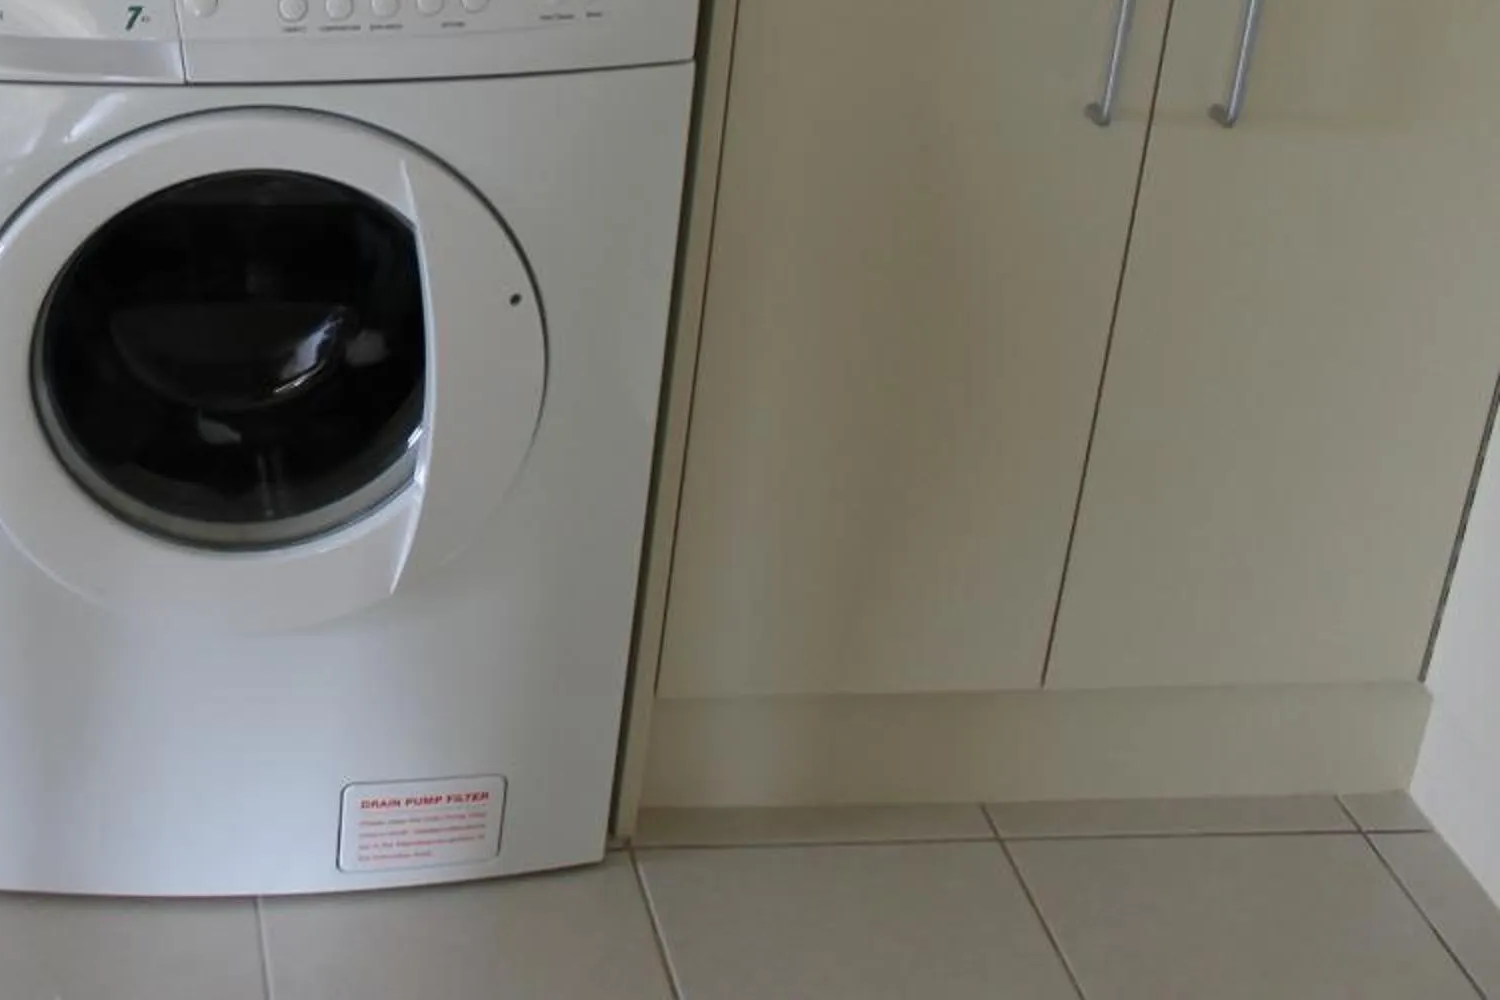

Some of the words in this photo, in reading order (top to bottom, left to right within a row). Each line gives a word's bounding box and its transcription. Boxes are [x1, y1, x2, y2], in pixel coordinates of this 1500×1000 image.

[124, 5, 145, 32] 7
[360, 798, 402, 810] DRAIN
[404, 796, 443, 808] PUMP
[446, 791, 490, 805] FILTER
